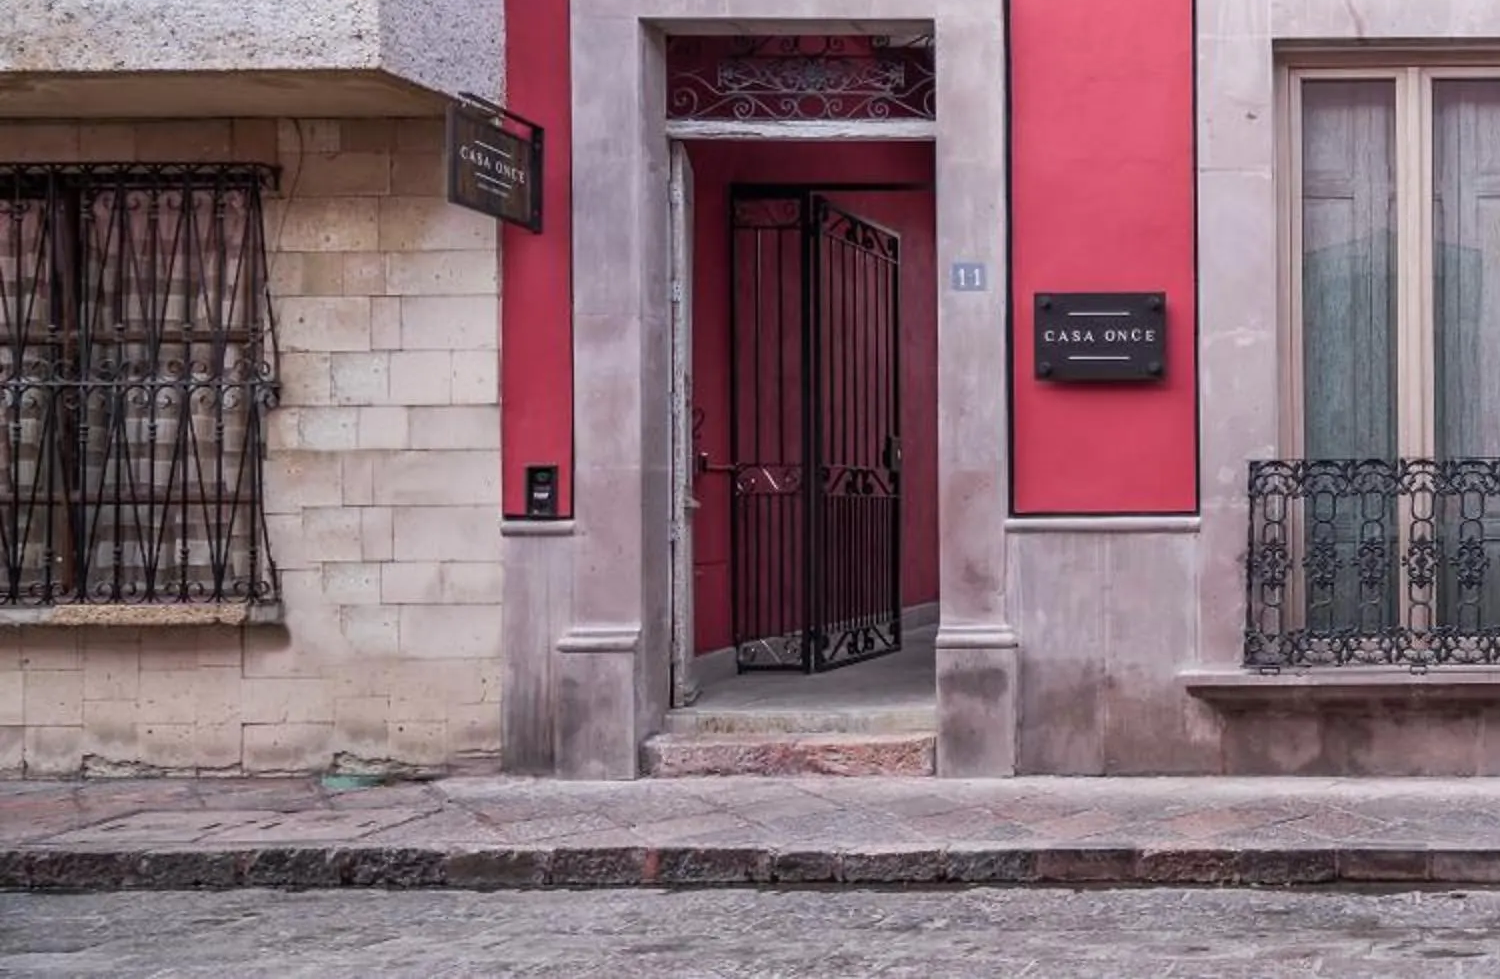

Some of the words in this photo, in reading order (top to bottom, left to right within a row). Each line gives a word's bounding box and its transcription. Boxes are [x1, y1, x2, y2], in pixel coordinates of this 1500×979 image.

[460, 145, 491, 170] CASA
[495, 160, 525, 184] ONCE
[958, 268, 981, 287] 11
[1044, 329, 1095, 343] CASA
[1104, 328, 1156, 343] ONCE
